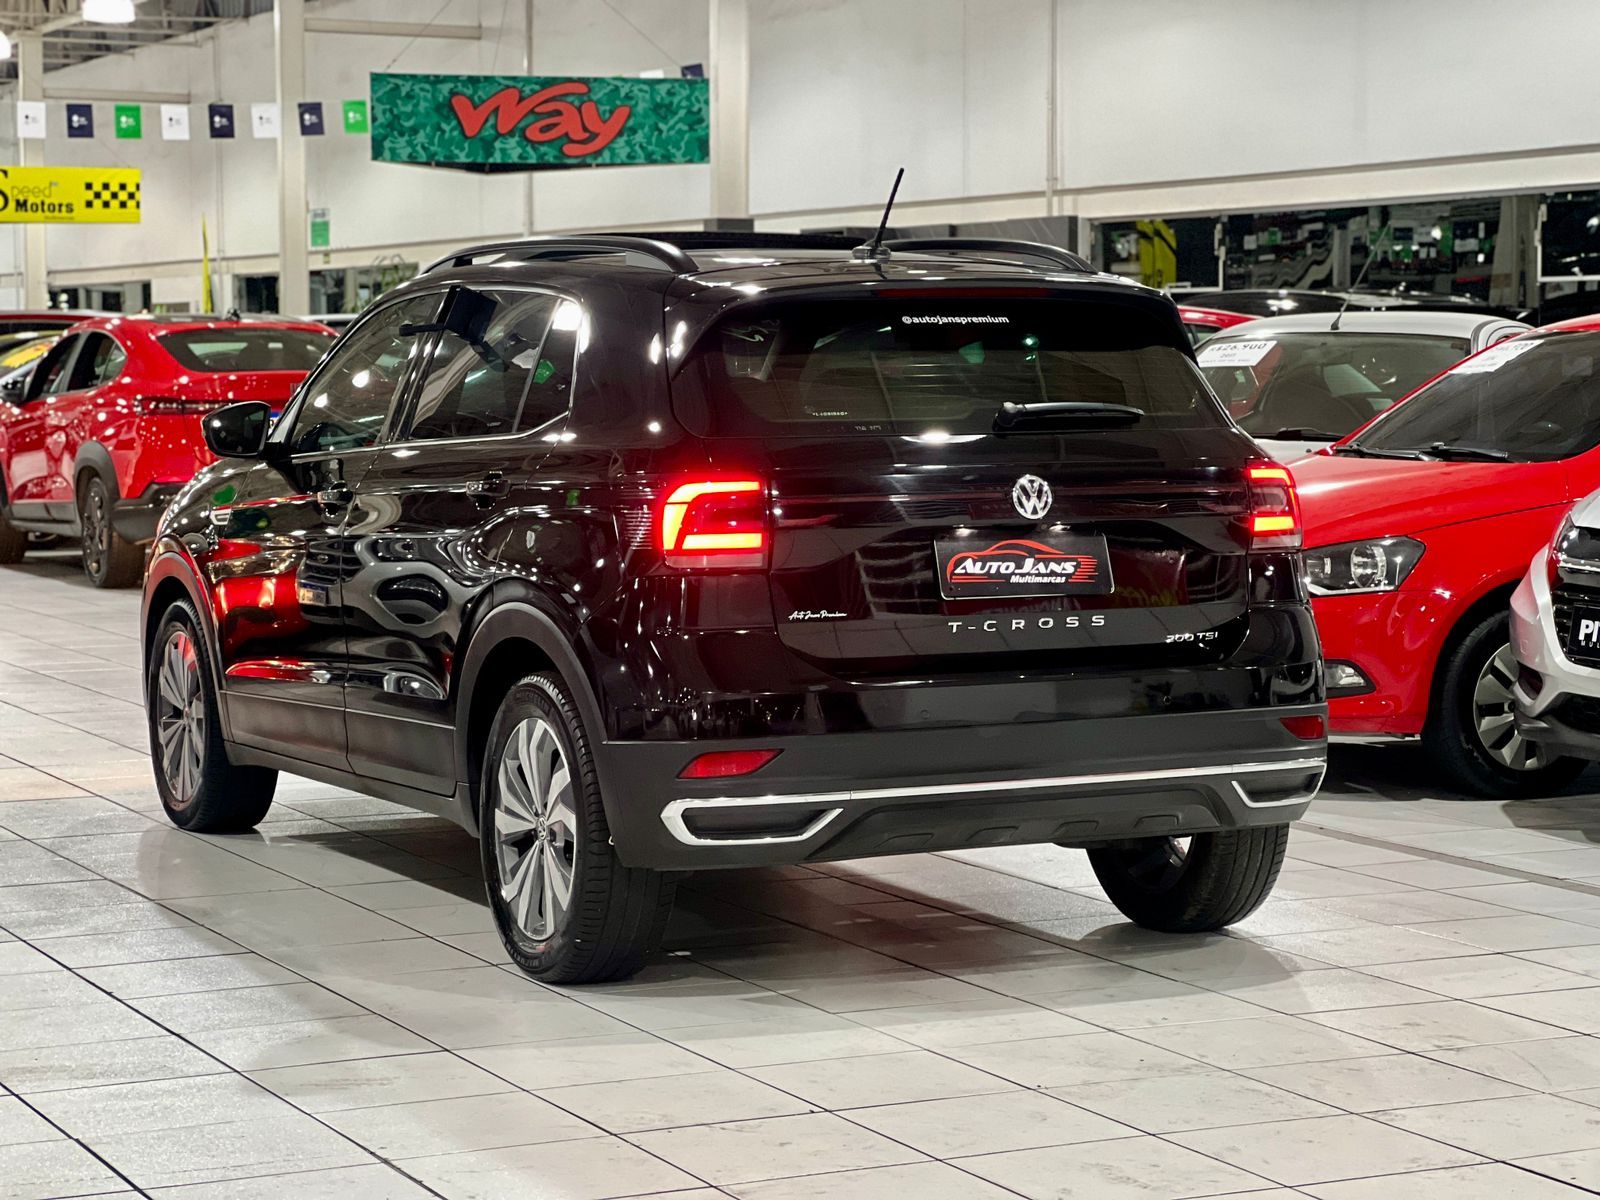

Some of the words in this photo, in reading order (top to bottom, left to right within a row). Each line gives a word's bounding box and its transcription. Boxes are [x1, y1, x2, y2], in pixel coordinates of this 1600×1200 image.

[15, 199, 75, 213] Motors
[902, 315, 1009, 325] @autojanspremium
[1010, 575, 1067, 584] Multimarcas
[948, 615, 1105, 633] T-CROSS
[1579, 619, 1600, 642] PI
[1165, 633, 1194, 643] 200
[1196, 631, 1219, 641] TSI
